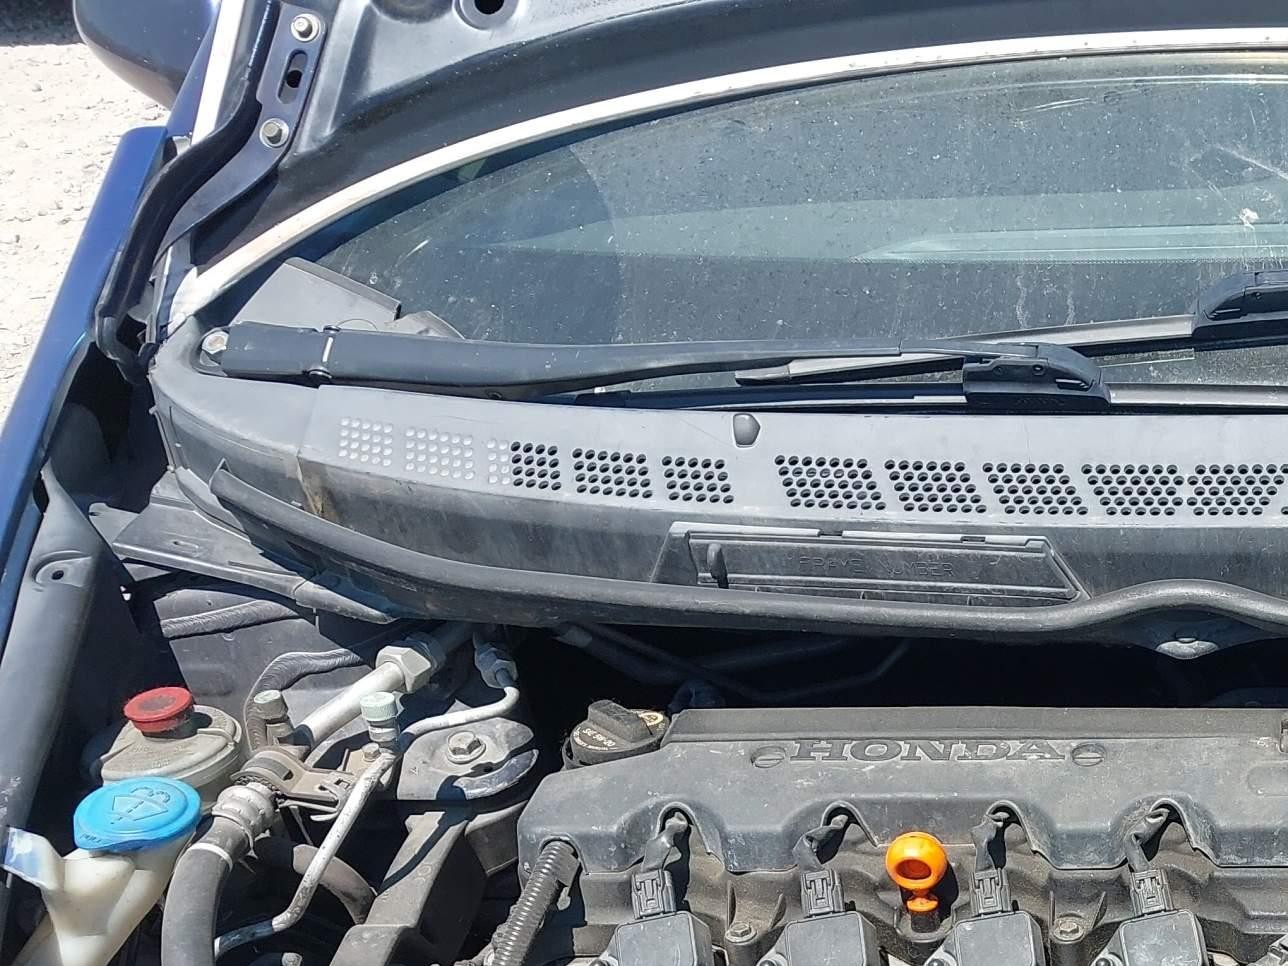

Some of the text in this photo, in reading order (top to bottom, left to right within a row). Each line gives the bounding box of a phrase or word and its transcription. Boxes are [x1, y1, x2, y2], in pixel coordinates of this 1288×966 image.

[799, 556, 955, 577] FRAME NUMBER
[790, 739, 1066, 761] HONDA
